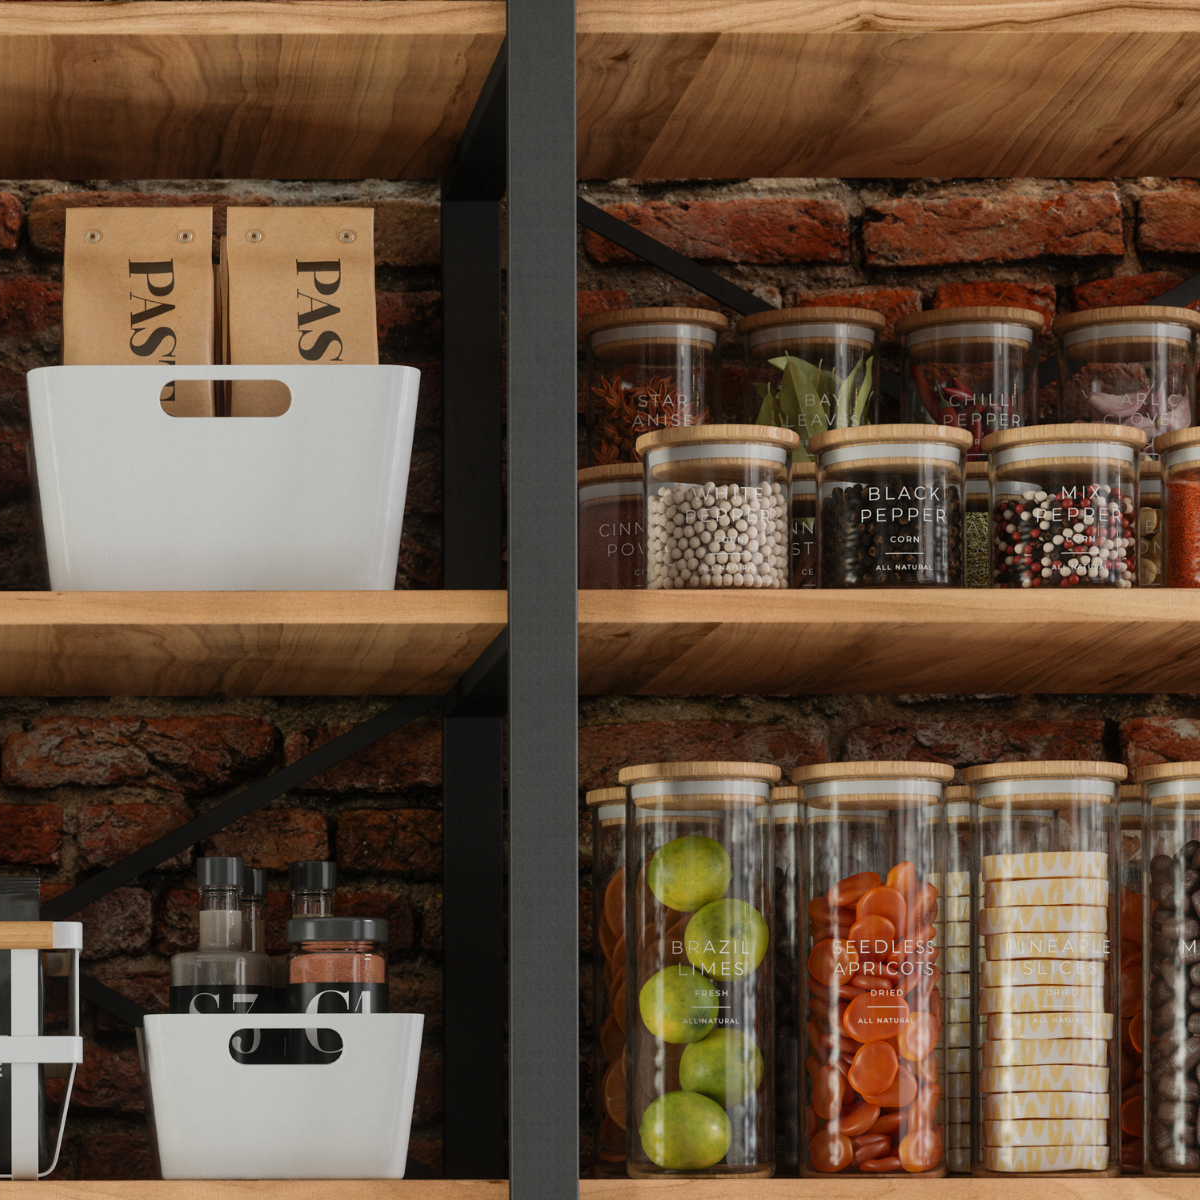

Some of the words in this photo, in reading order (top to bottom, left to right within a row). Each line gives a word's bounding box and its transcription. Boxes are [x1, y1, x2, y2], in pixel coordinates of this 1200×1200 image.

[296, 258, 343, 363] PAS
[129, 258, 177, 402] PAS
[638, 394, 688, 408] STAR
[805, 393, 843, 407] BAY
[949, 393, 1015, 407] CHILLI
[632, 413, 693, 428] ANISE
[786, 413, 859, 428] LEAVES
[943, 412, 1021, 427] PEPPER
[692, 486, 763, 501] WHITE
[868, 486, 940, 501] BLACK
[1061, 486, 1100, 500] MIX
[685, 508, 770, 523] PEPPER
[861, 508, 946, 523] PEPPER
[1036, 507, 1121, 522] PEPPER
[890, 535, 920, 543] CORN
[1066, 535, 1096, 543] CORN
[672, 940, 750, 955] BRAZIL
[833, 940, 935, 955] SEEDLESS
[1006, 939, 1110, 954] PINEAPLE
[678, 962, 744, 976] LIMES
[833, 961, 934, 976] APRICOTS
[1022, 961, 1098, 975] SLICES
[695, 989, 729, 997] FRESH
[870, 989, 904, 997] DRIED
